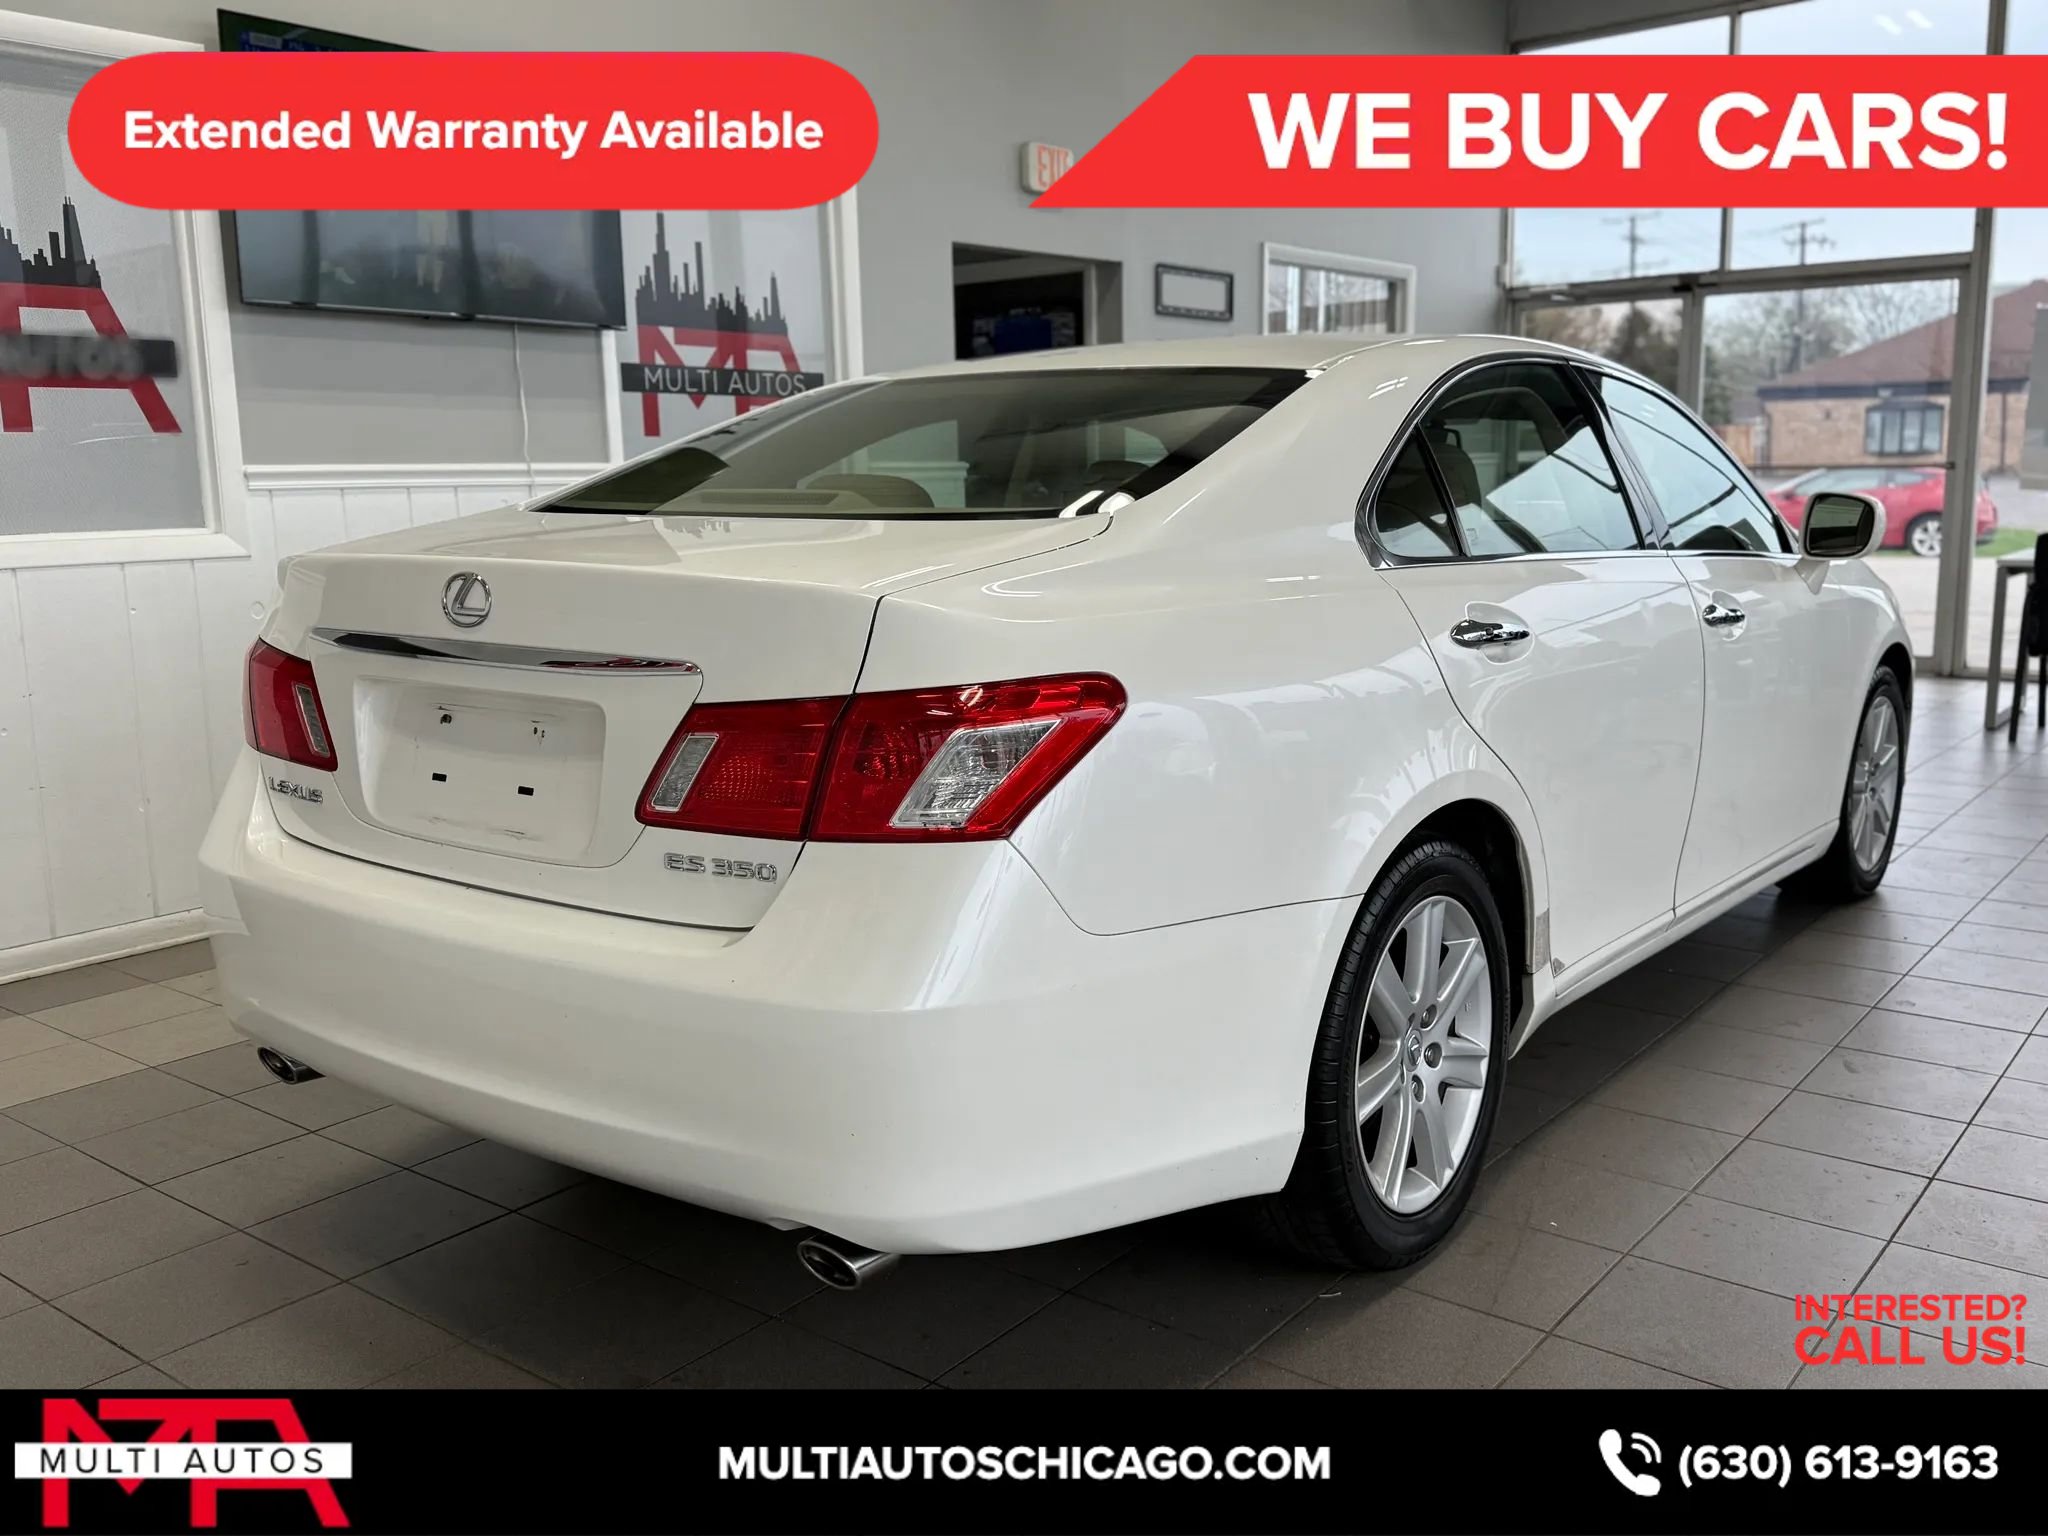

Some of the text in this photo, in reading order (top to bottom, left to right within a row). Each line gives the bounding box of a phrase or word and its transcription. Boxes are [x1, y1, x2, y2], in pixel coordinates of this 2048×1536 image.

[643, 366, 805, 396] MULTI AUTOS
[268, 776, 324, 803] LEXUS
[663, 852, 778, 882] ES 350
